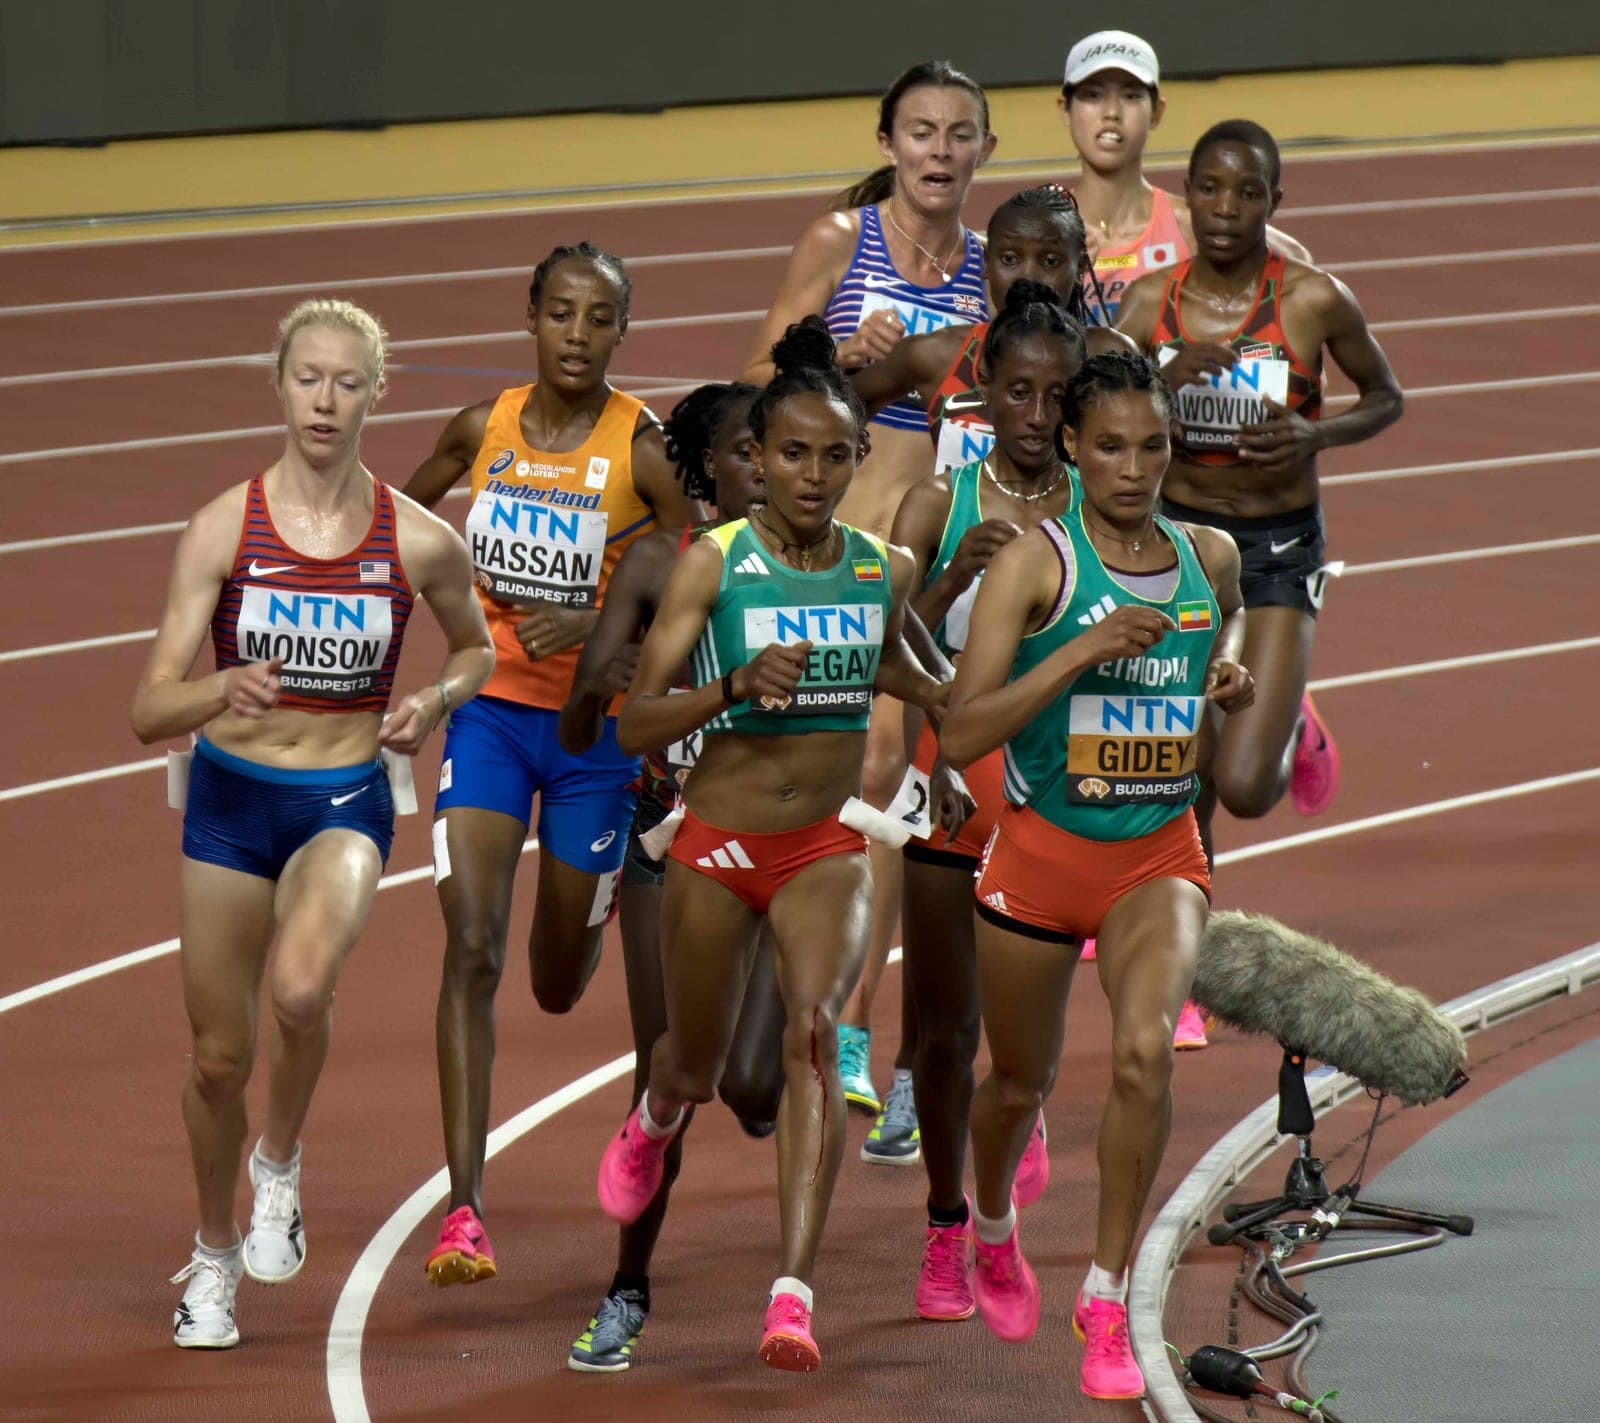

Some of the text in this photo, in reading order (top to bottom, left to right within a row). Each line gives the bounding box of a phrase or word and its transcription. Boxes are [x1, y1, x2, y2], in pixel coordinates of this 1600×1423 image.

[1081, 43, 1140, 62] JAPAN
[1186, 431, 1233, 445] BUDAP
[490, 498, 579, 546] NTN
[472, 532, 593, 582] HASSAN
[495, 580, 571, 603] BUDAPEST
[268, 592, 365, 633] NTN
[776, 606, 867, 643] NTN
[246, 630, 380, 670] MONSON
[805, 648, 876, 682] EGAY
[280, 675, 357, 692] BUDAPEST
[797, 691, 865, 705] BUDAPES
[1102, 697, 1196, 734] NTN
[1098, 739, 1192, 772] GIDEY
[1115, 782, 1184, 795] BUDAPEST
